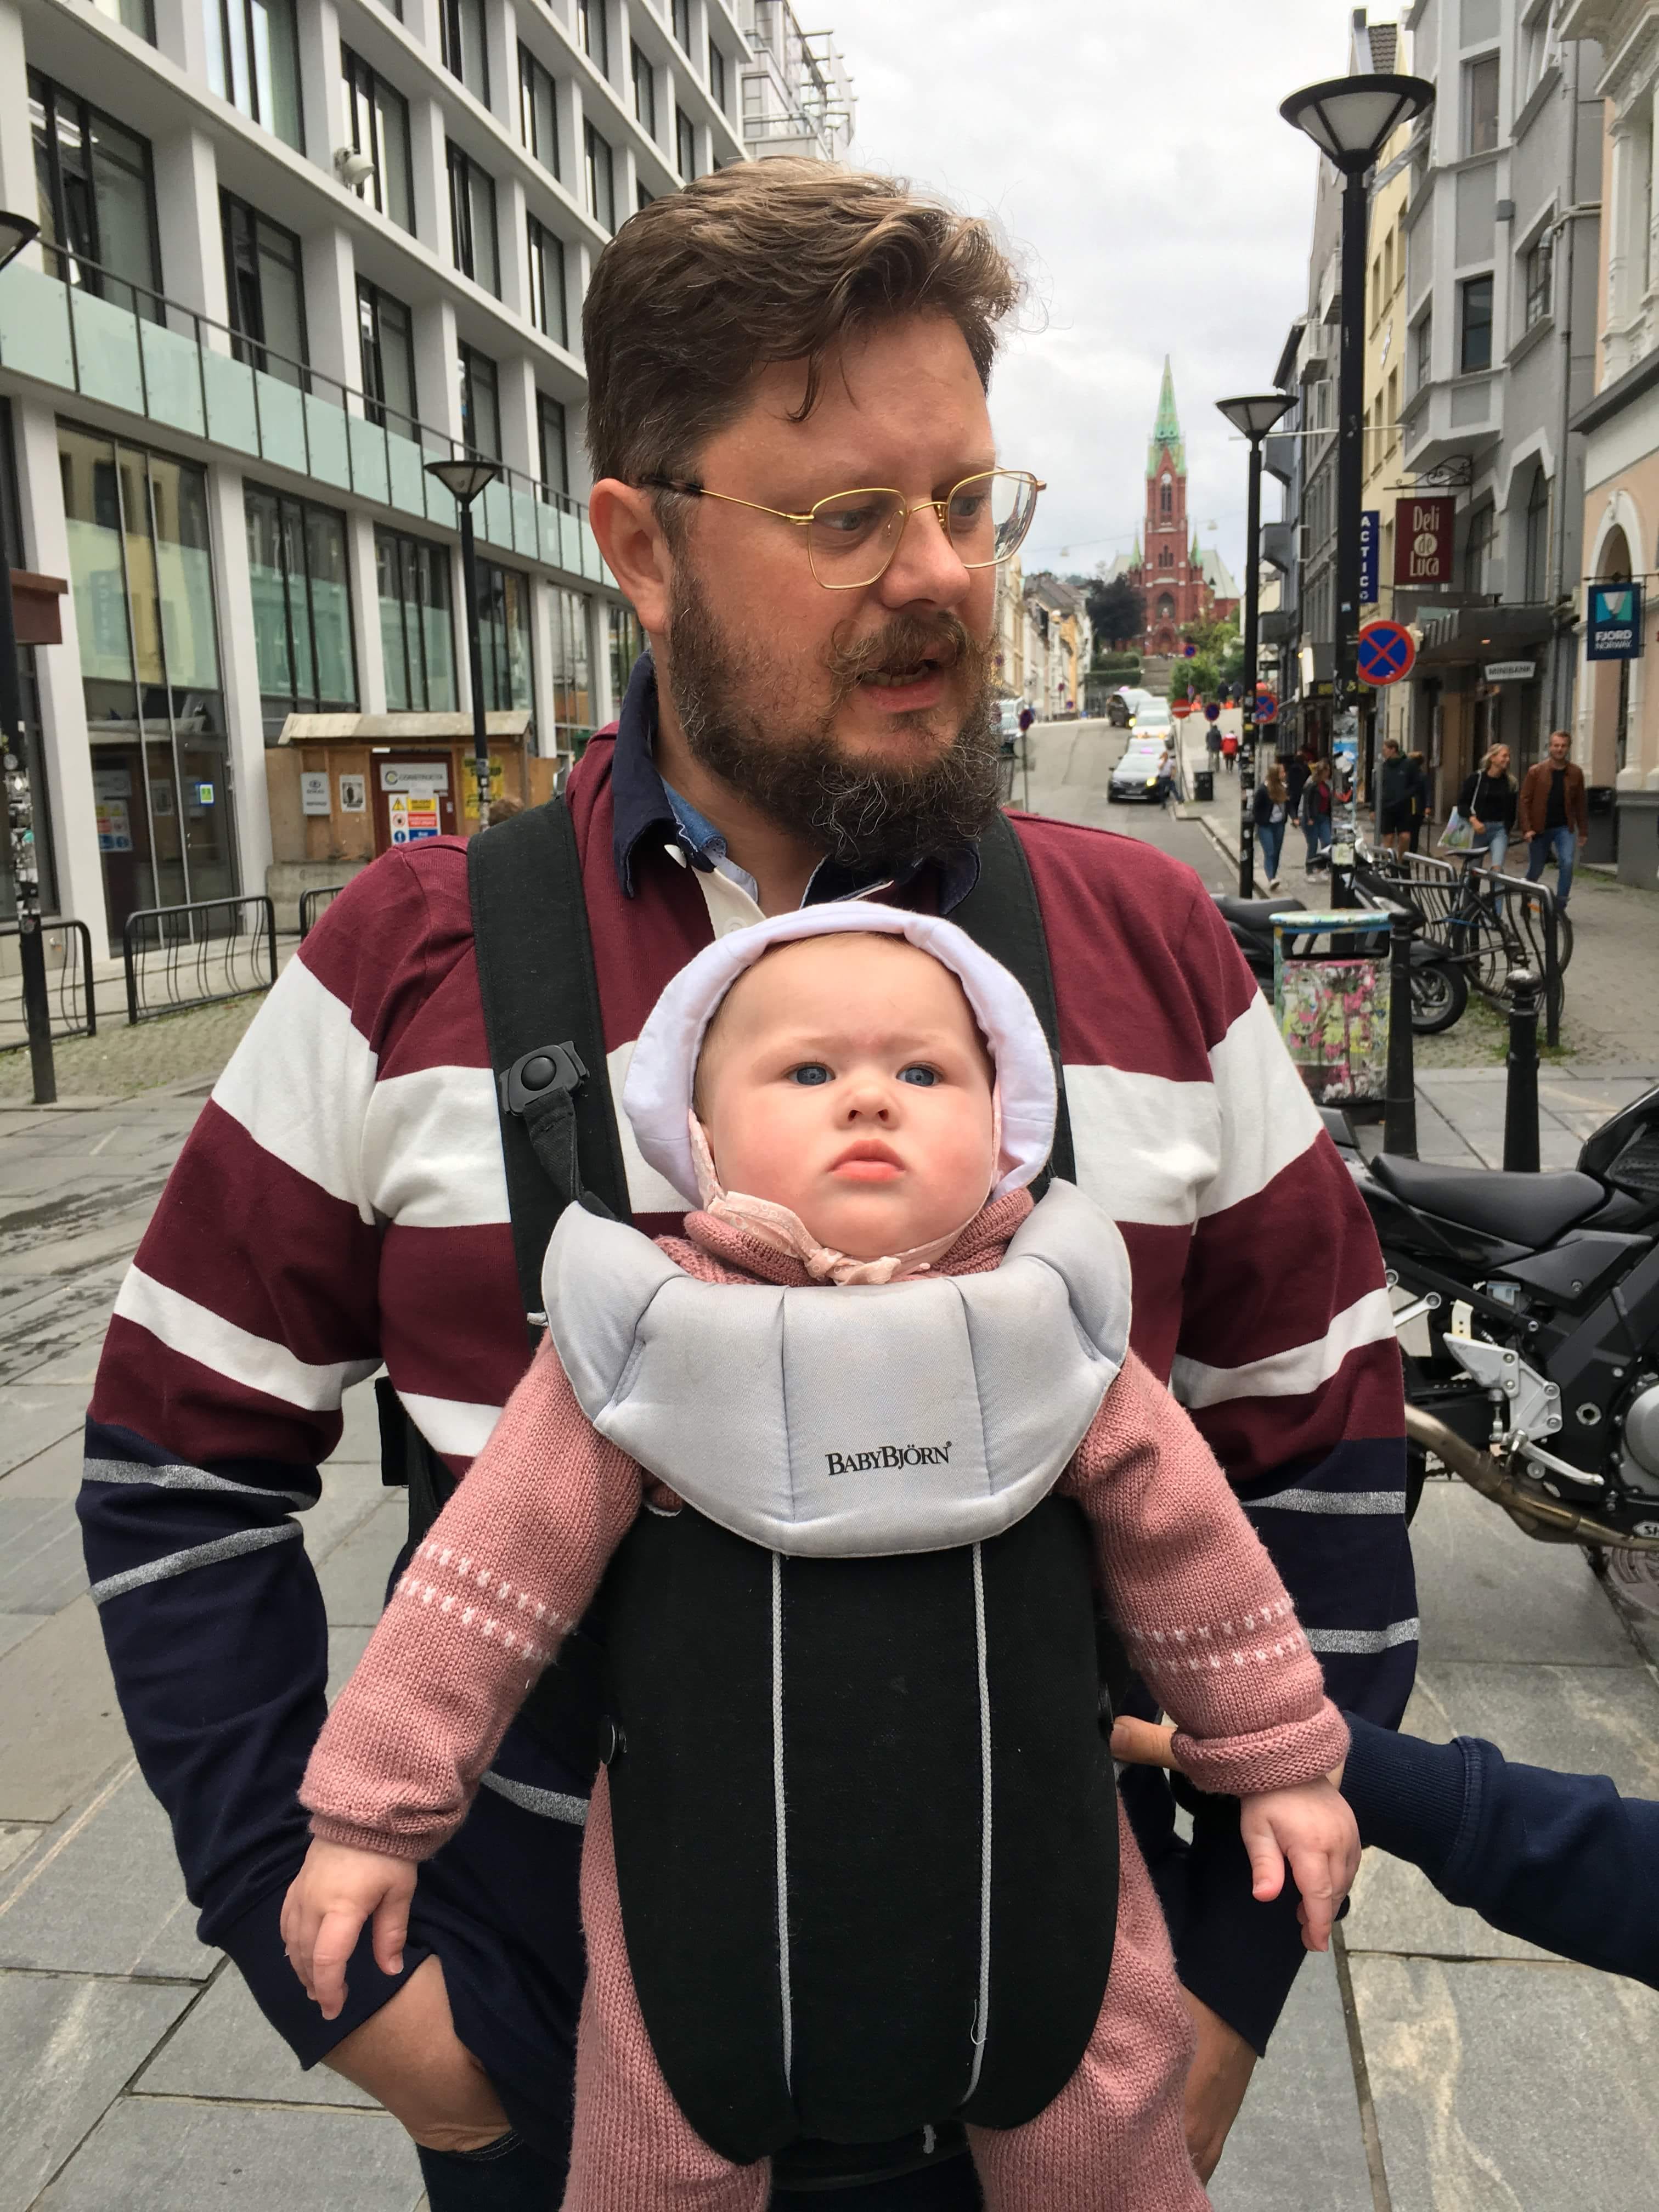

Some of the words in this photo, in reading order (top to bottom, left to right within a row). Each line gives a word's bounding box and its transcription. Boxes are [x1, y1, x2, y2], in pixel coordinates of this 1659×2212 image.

[1413, 505, 1440, 532] Deli
[1418, 534, 1433, 554] de
[1409, 550, 1440, 577] Luca
[1595, 629, 1633, 641] FJORD
[1595, 640, 1633, 651] NORWAY
[1489, 665, 1532, 675] MINIBANK
